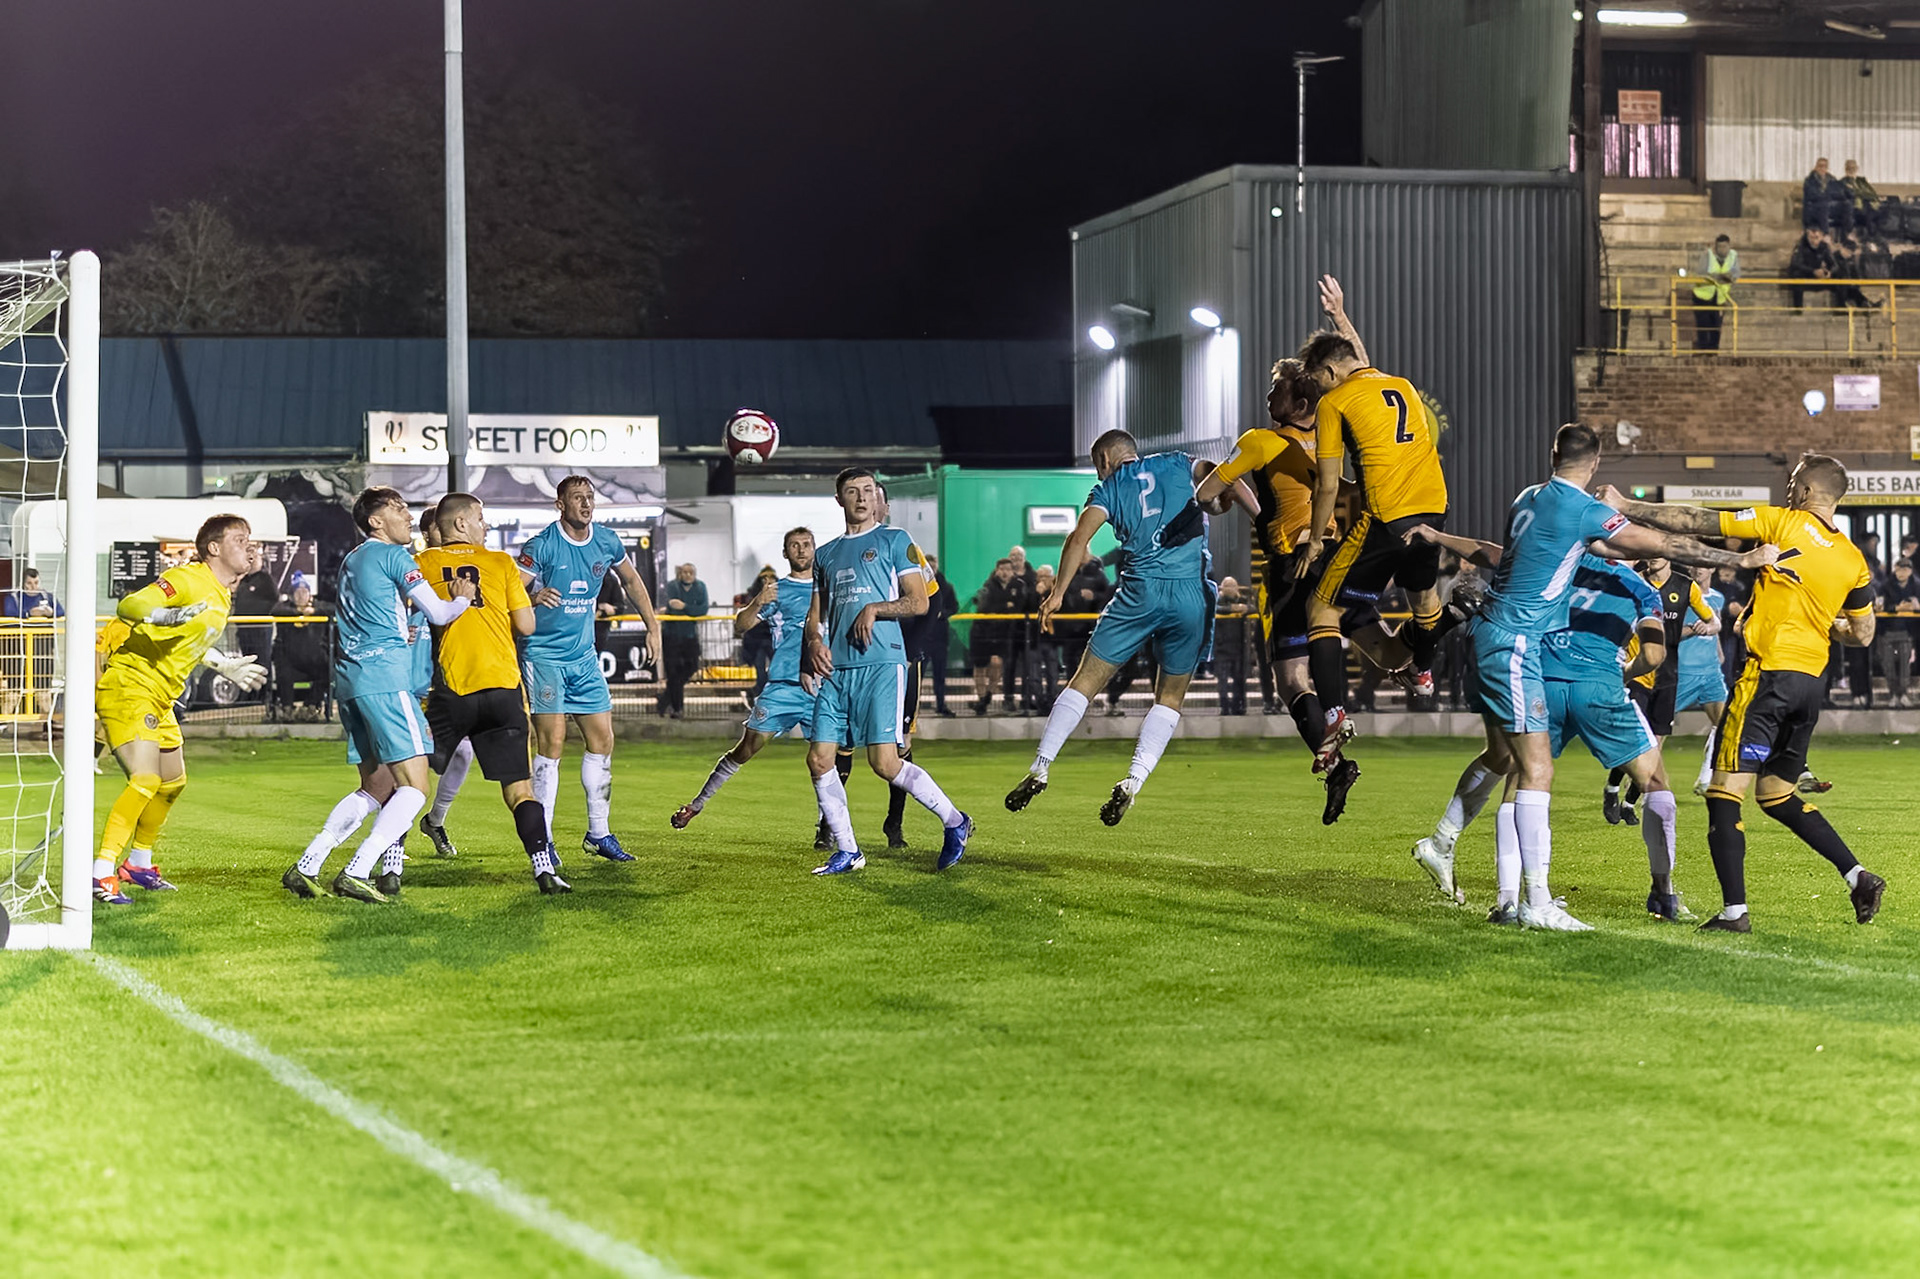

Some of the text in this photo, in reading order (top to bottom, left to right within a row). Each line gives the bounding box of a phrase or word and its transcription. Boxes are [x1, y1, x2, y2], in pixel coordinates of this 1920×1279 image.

[1381, 389, 1415, 444] 2
[534, 427, 607, 453] FOOD
[1136, 472, 1161, 518] 2
[1691, 489, 1743, 498] SNACK BAR
[1847, 477, 1886, 492] BLES
